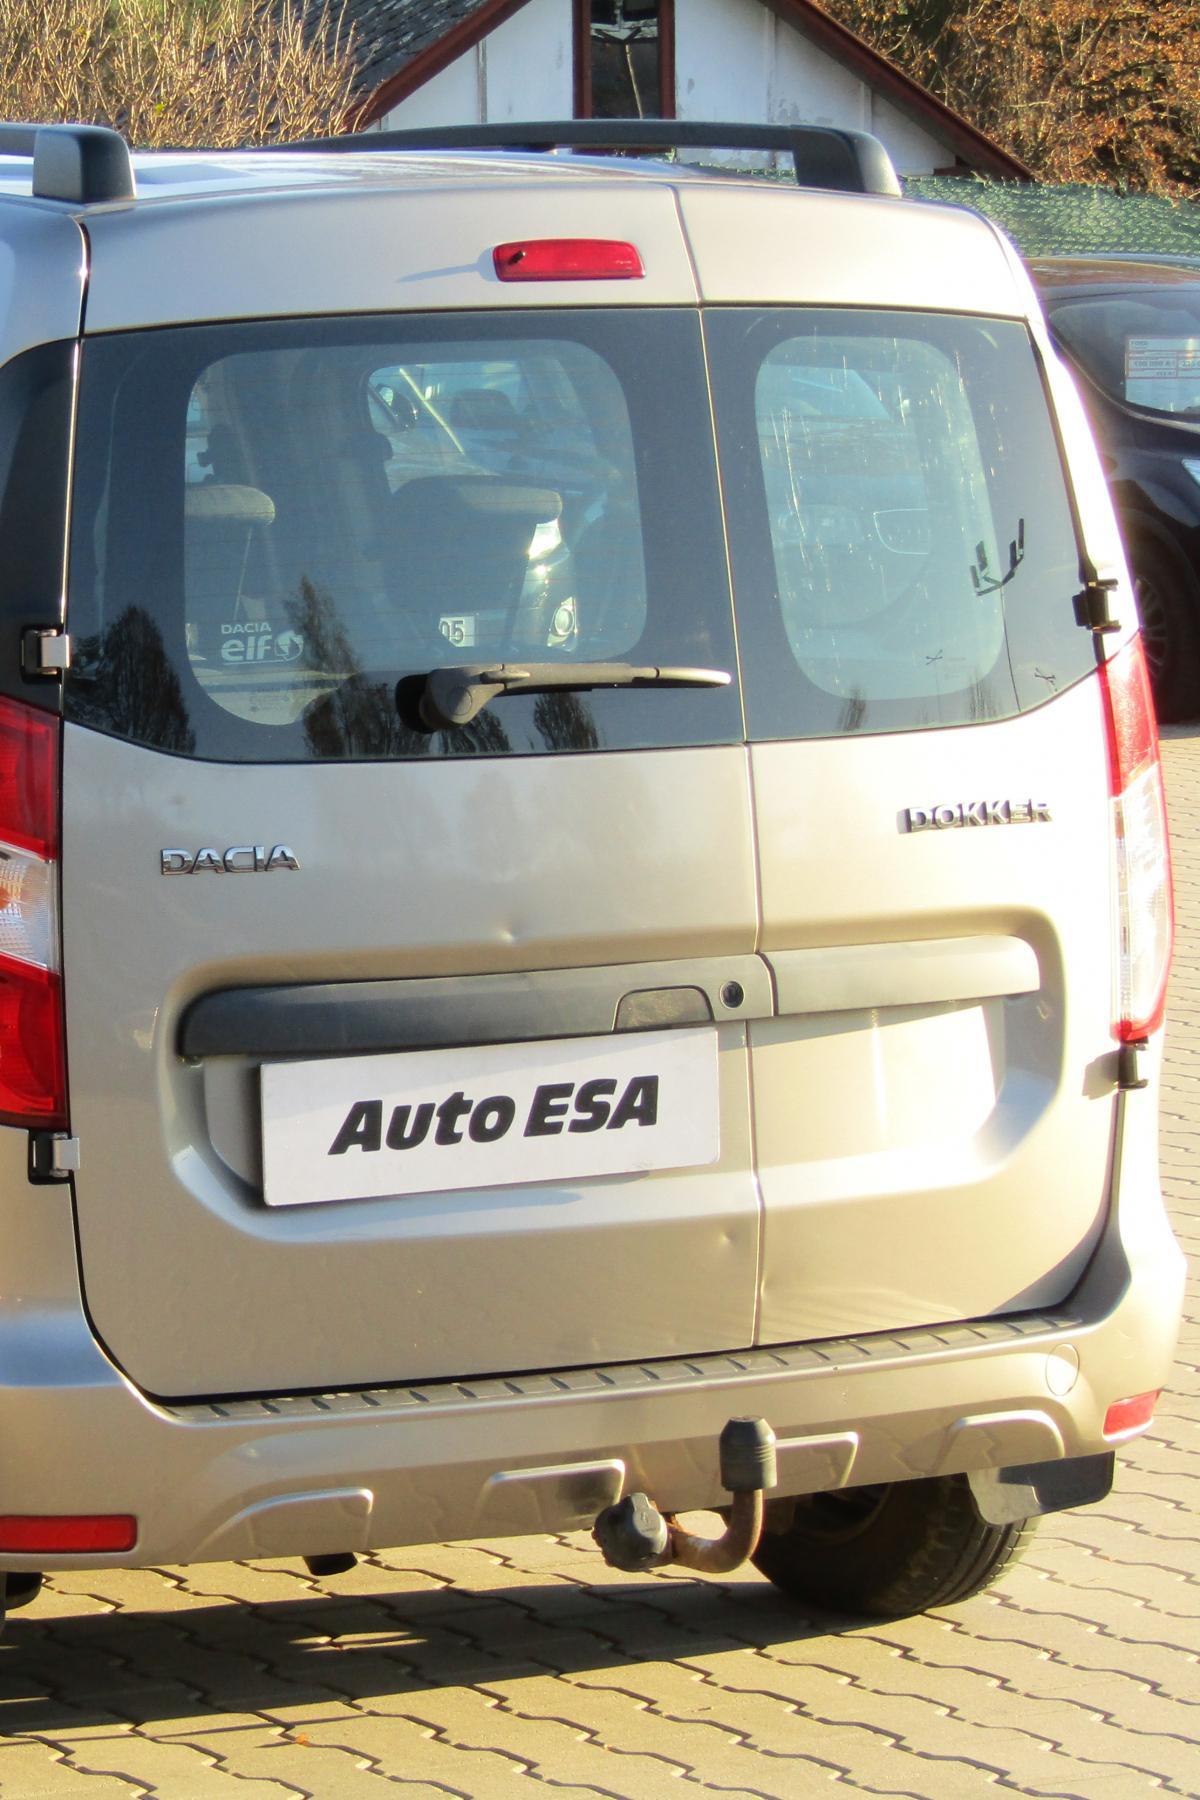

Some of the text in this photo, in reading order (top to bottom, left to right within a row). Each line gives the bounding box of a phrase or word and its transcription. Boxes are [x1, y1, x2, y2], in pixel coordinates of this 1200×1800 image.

[220, 622, 272, 635] DACIA
[221, 634, 273, 662] elf
[896, 798, 1053, 834] DOKKER
[161, 844, 301, 876] DACIA
[327, 1074, 660, 1156] Auto ESA
